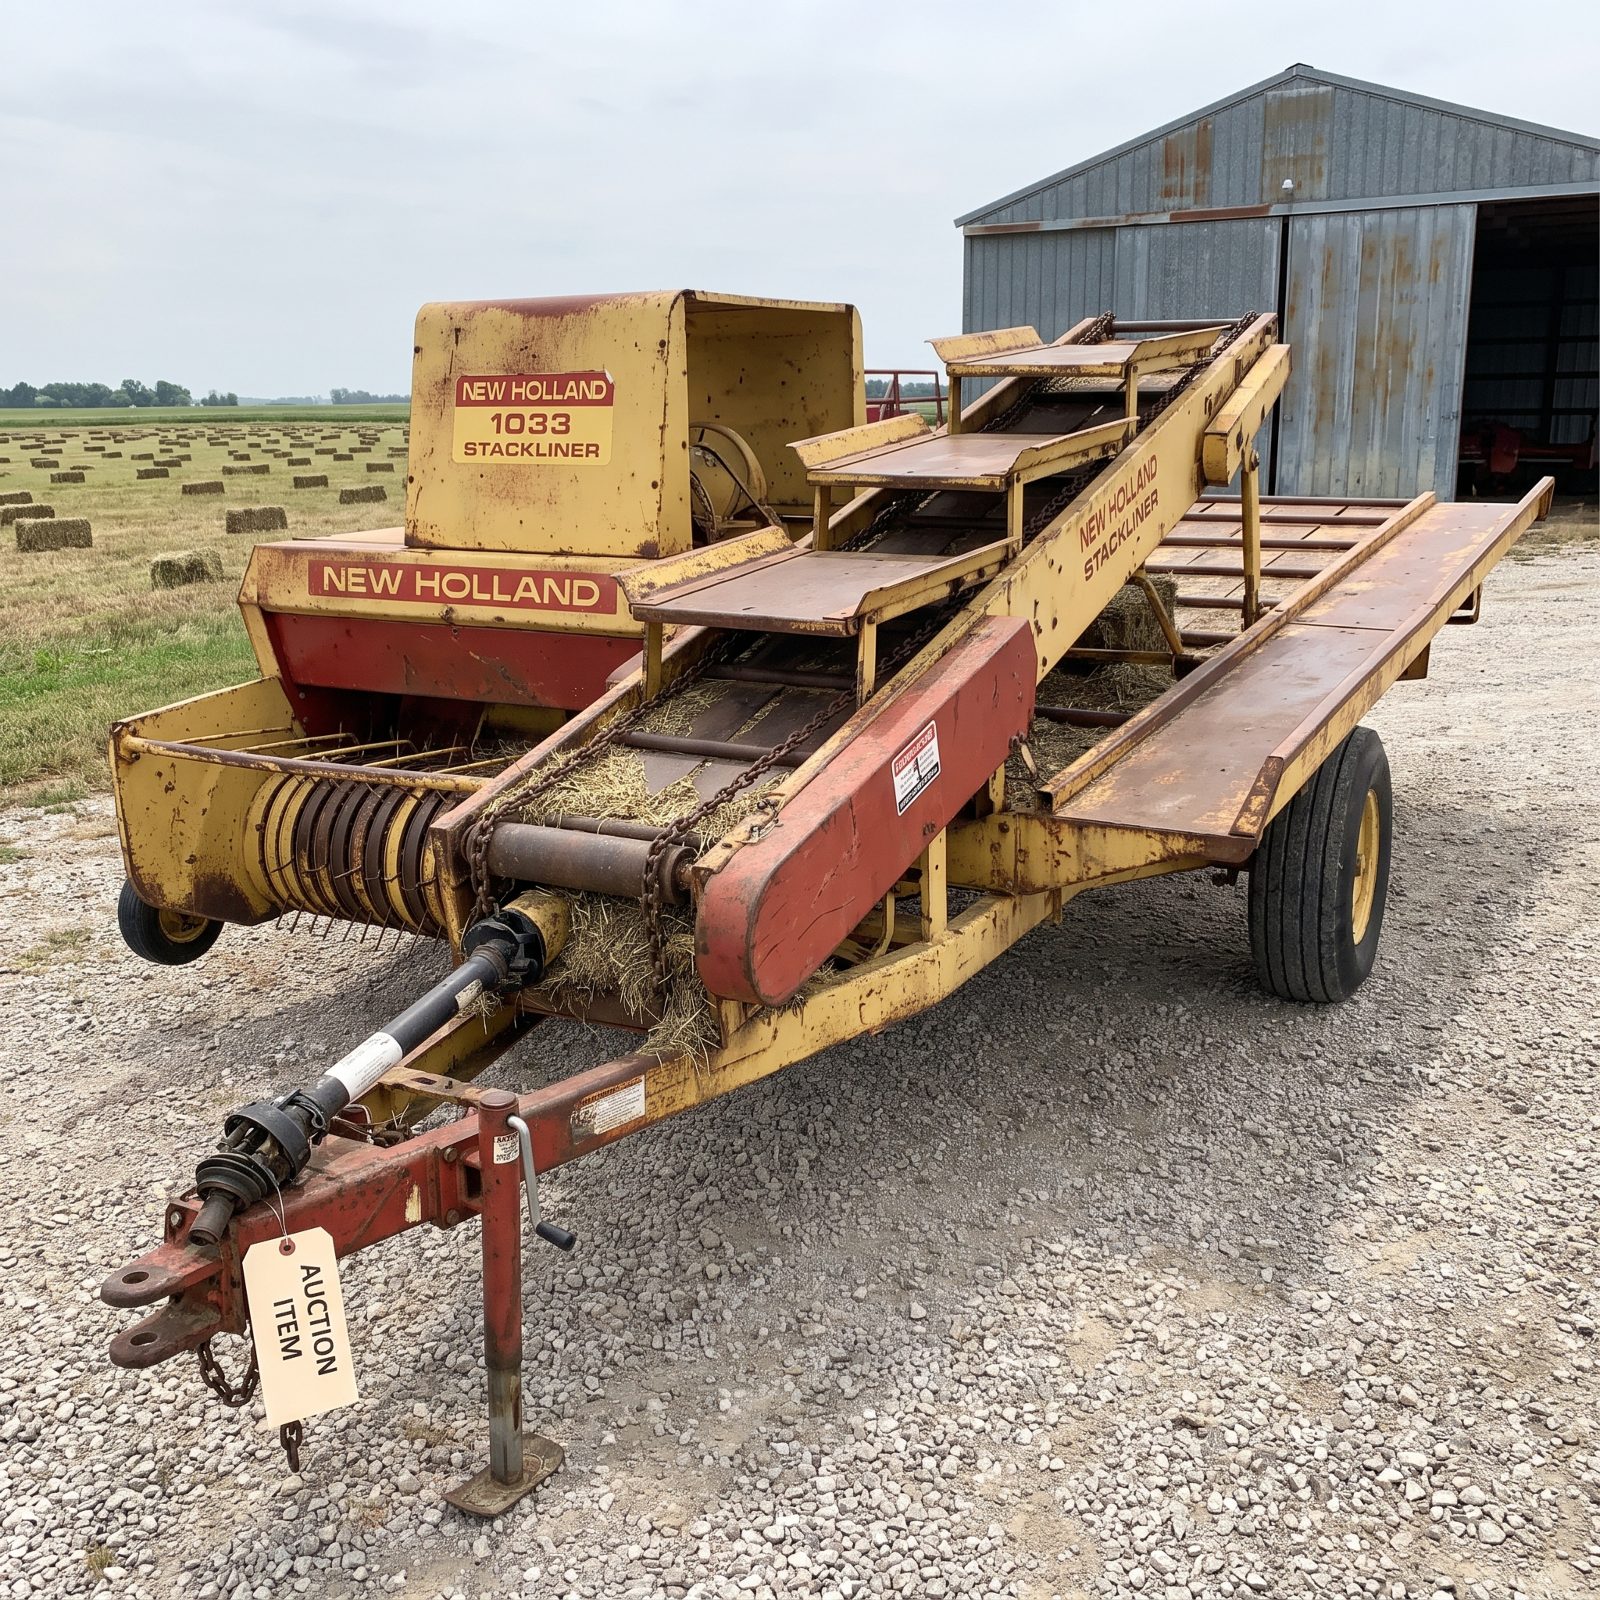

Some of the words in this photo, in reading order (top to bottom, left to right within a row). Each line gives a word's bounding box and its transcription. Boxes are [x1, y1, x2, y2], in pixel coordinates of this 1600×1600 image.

[463, 381, 506, 401] NEW
[512, 380, 606, 401] HOLLAND
[464, 441, 600, 458] STACKLINER
[491, 412, 571, 435] 1033
[1079, 503, 1106, 553] NEW
[1108, 454, 1158, 523] HOLLAND
[1084, 488, 1159, 582] STACKLINER
[323, 566, 403, 595] NEW
[415, 571, 600, 607] HOLLAND
[273, 1298, 303, 1361] ITEM
[300, 1265, 338, 1376] AUCTION
